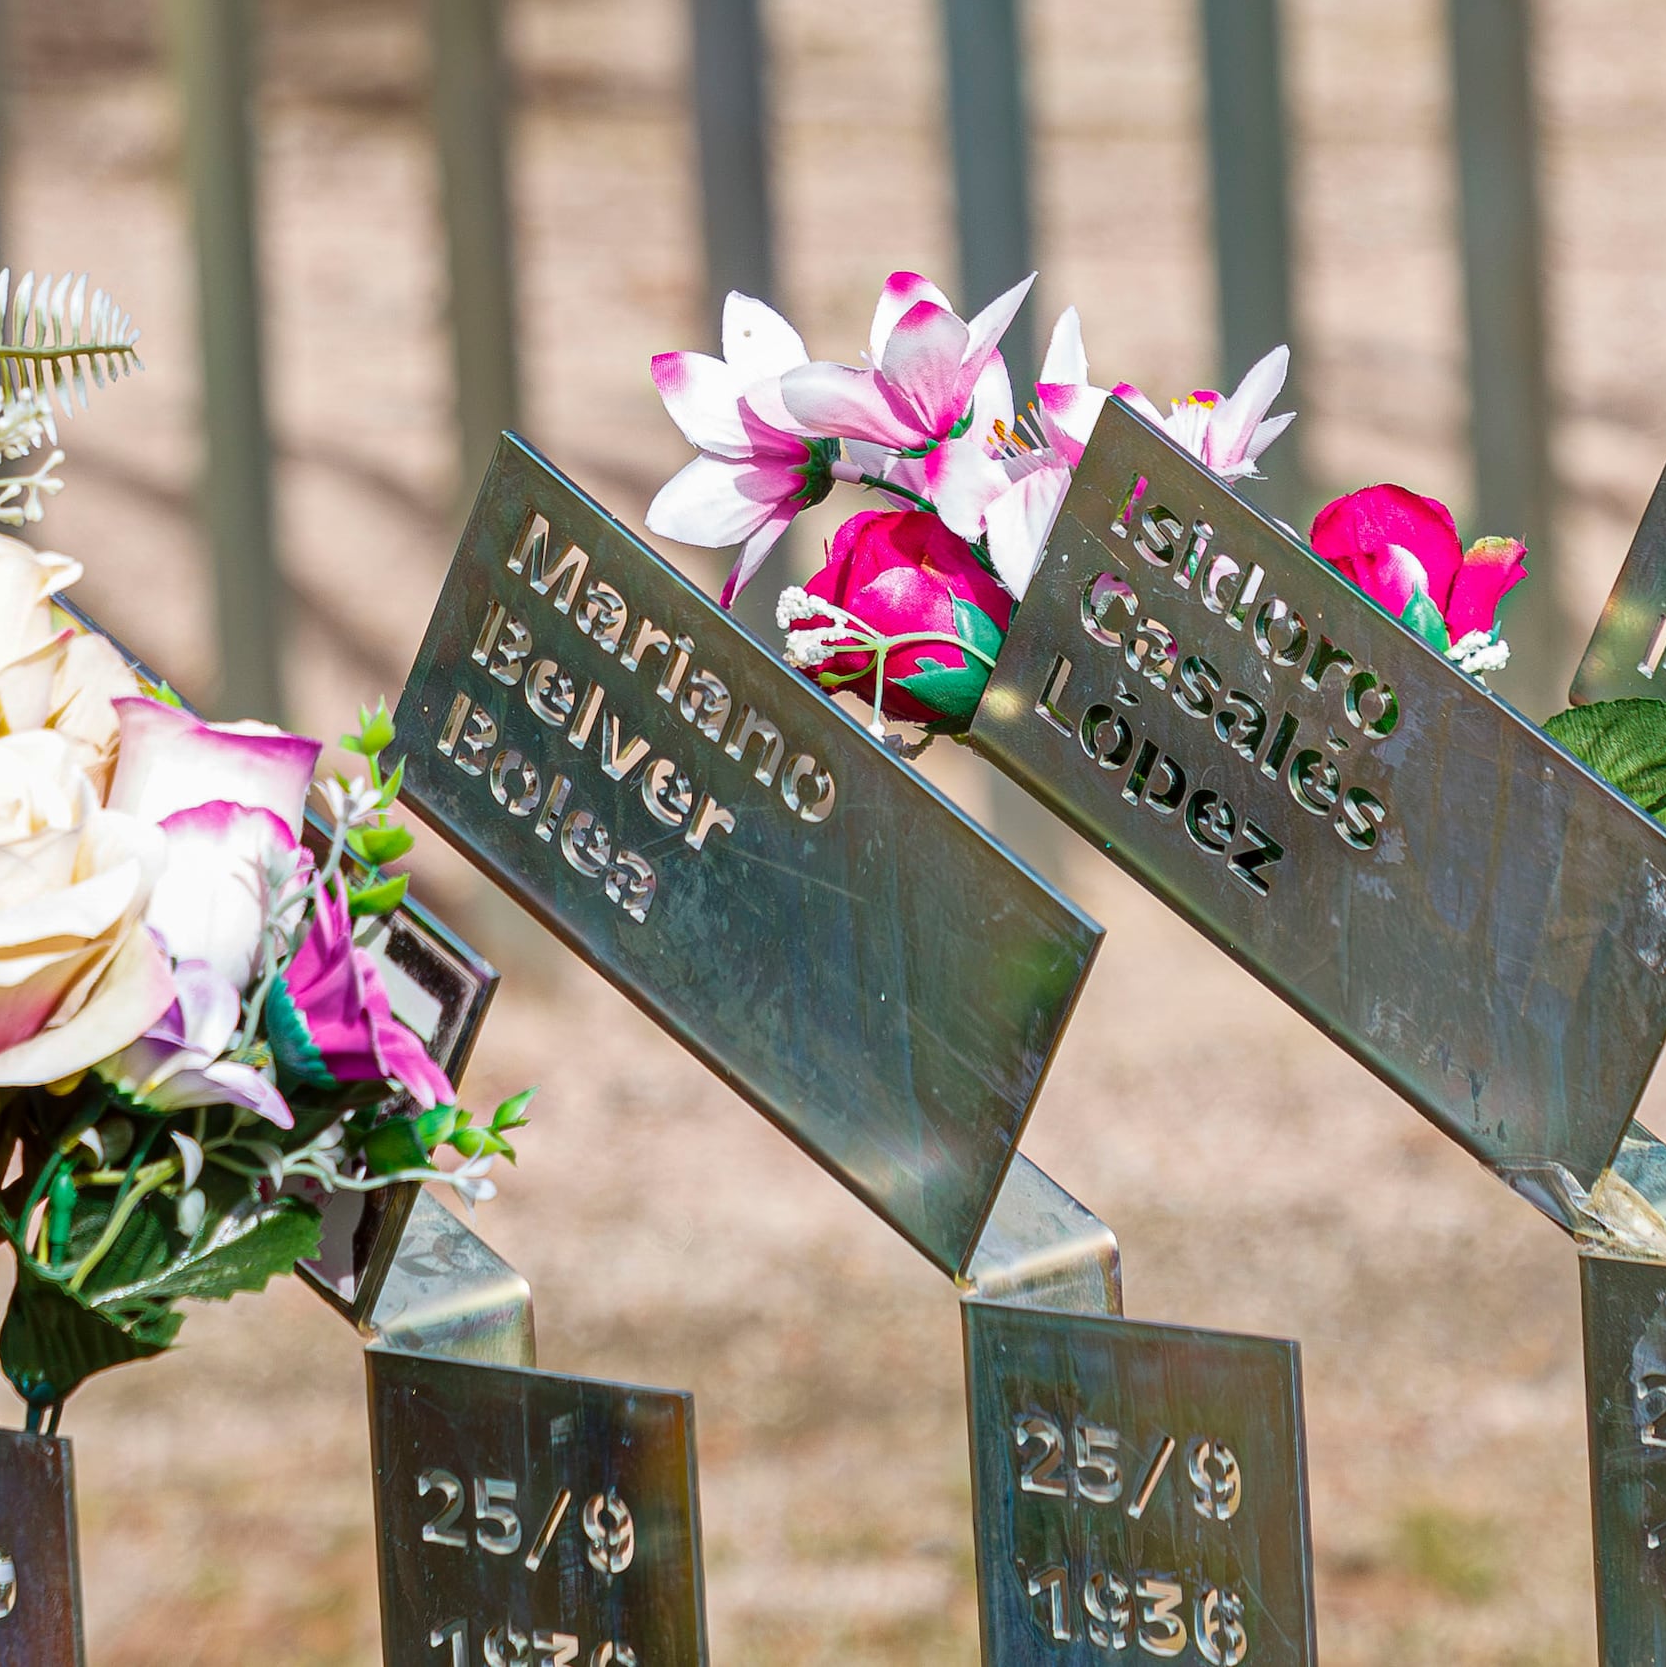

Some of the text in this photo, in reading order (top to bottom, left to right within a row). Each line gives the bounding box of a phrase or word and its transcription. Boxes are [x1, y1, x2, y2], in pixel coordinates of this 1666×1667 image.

[471, 600, 735, 850] Belver
[507, 508, 835, 824] Mariano
[1081, 570, 1386, 851] Casales
[1110, 472, 1401, 739] Isidoro
[436, 691, 656, 924] Bolea
[1034, 652, 1286, 897] López
[418, 1468, 635, 1575] 25/9
[1016, 1417, 1243, 1521] 25/9
[1028, 1566, 1250, 1667] 1936
